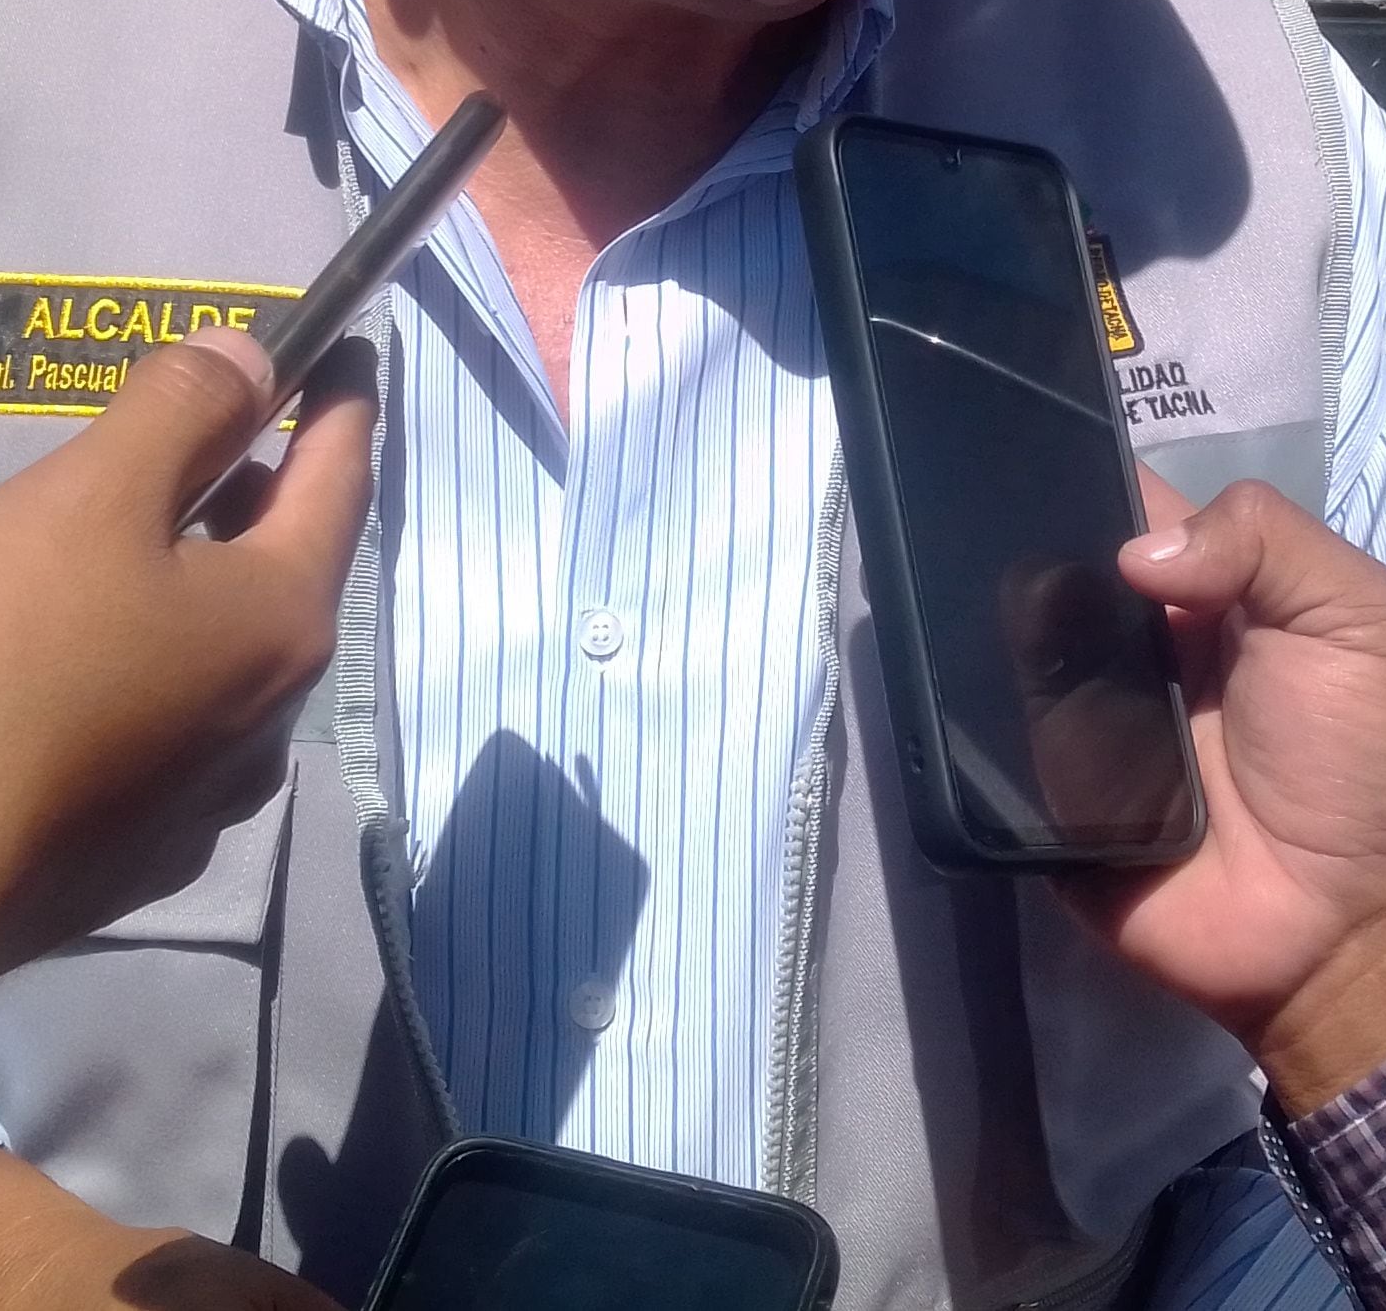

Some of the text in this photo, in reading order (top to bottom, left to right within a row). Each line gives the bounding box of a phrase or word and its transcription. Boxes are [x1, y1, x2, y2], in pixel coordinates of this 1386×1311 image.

[21, 296, 256, 344] ALCALDE
[27, 353, 129, 392] Pascual
[1117, 361, 1189, 394] LIDAD
[1145, 390, 1216, 421] TACNA
